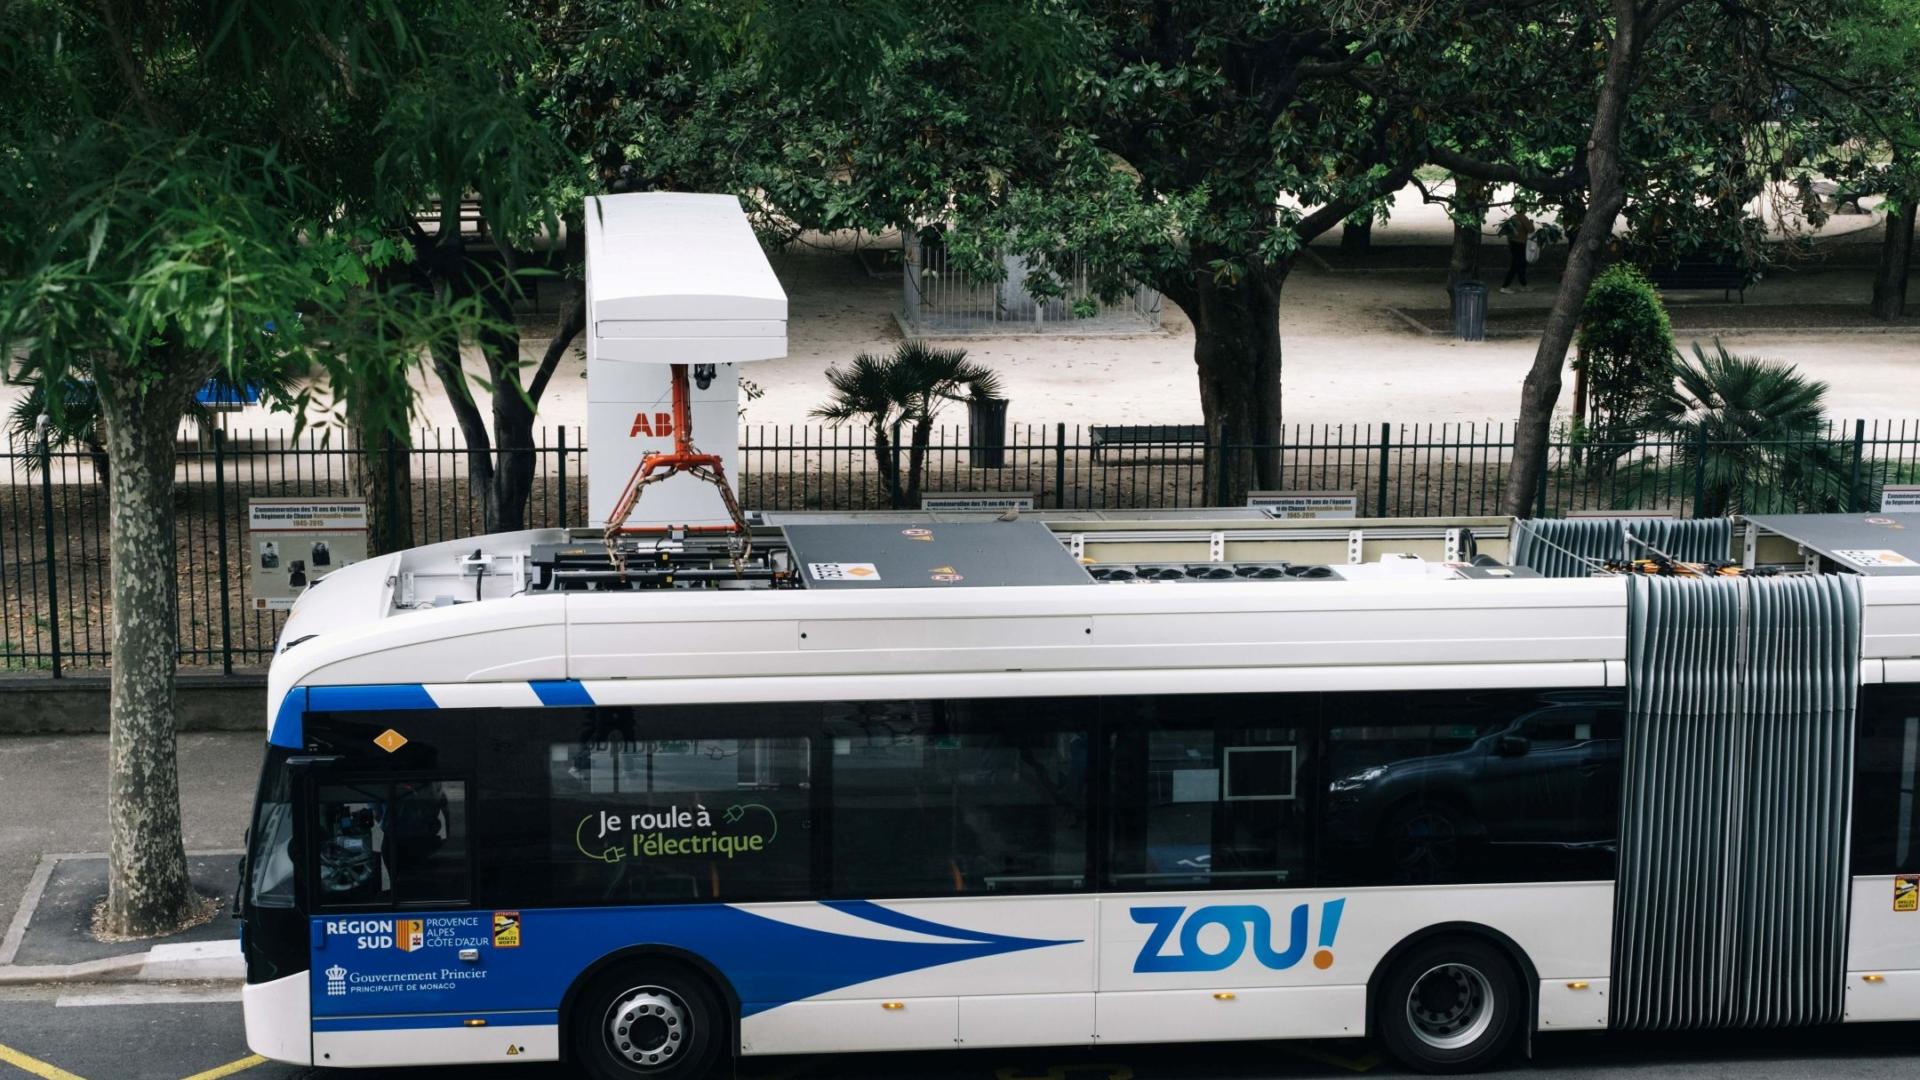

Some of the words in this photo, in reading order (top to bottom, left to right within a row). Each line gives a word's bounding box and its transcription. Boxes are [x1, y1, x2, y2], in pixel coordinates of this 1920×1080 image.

[630, 412, 673, 437] AB
[598, 810, 622, 838] Je
[631, 806, 692, 830] roule
[697, 804, 711, 827] à
[632, 831, 763, 859] l'électrique
[327, 920, 392, 934] RÉGION
[427, 918, 478, 926] PROVENCE
[427, 928, 455, 937] ALPES
[1130, 898, 1346, 973] ZOU!
[358, 936, 392, 949] SUD
[427, 937, 454, 947] CÔTE
[455, 937, 489, 946] D'AZUR
[350, 972, 437, 983] Gouvernement
[441, 968, 488, 979] Princier
